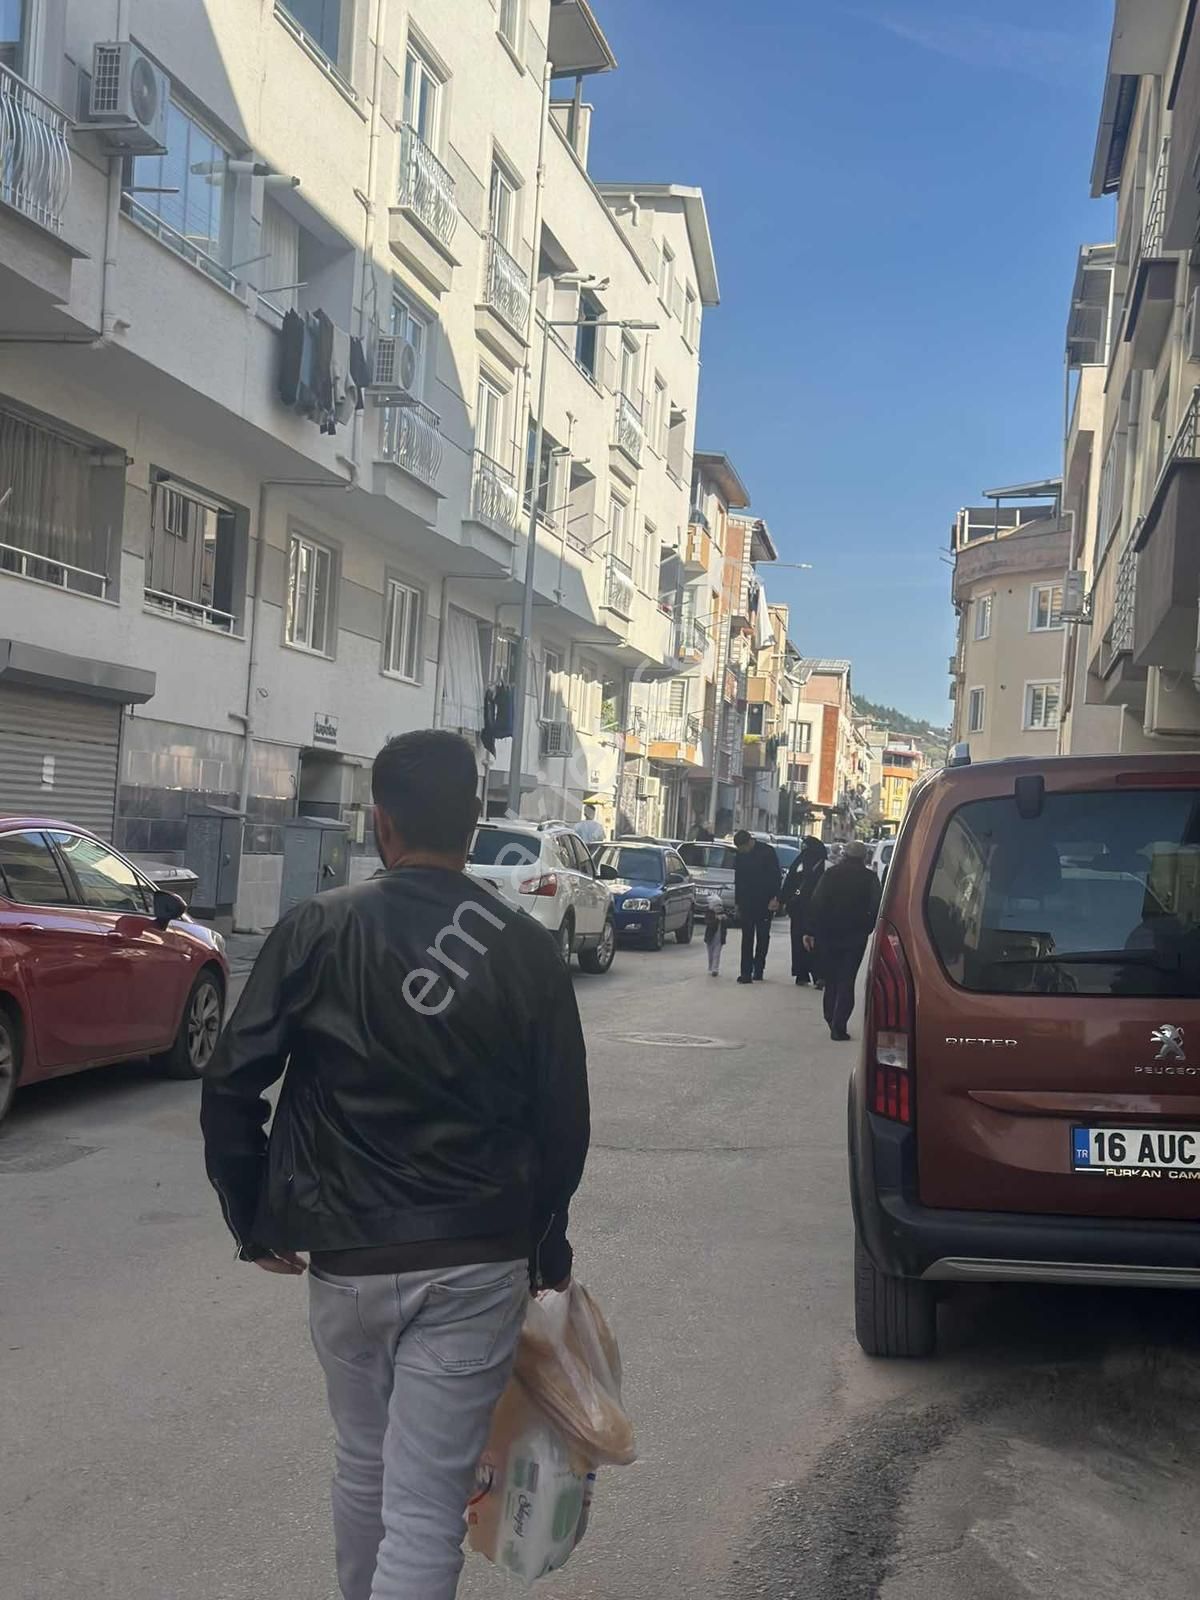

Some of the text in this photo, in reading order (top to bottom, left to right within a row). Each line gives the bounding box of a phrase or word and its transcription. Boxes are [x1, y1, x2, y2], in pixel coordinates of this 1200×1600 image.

[1094, 1132, 1196, 1164] 16 AUC
[1075, 1149, 1089, 1158] TR
[1106, 1168, 1161, 1178] FURKAN
